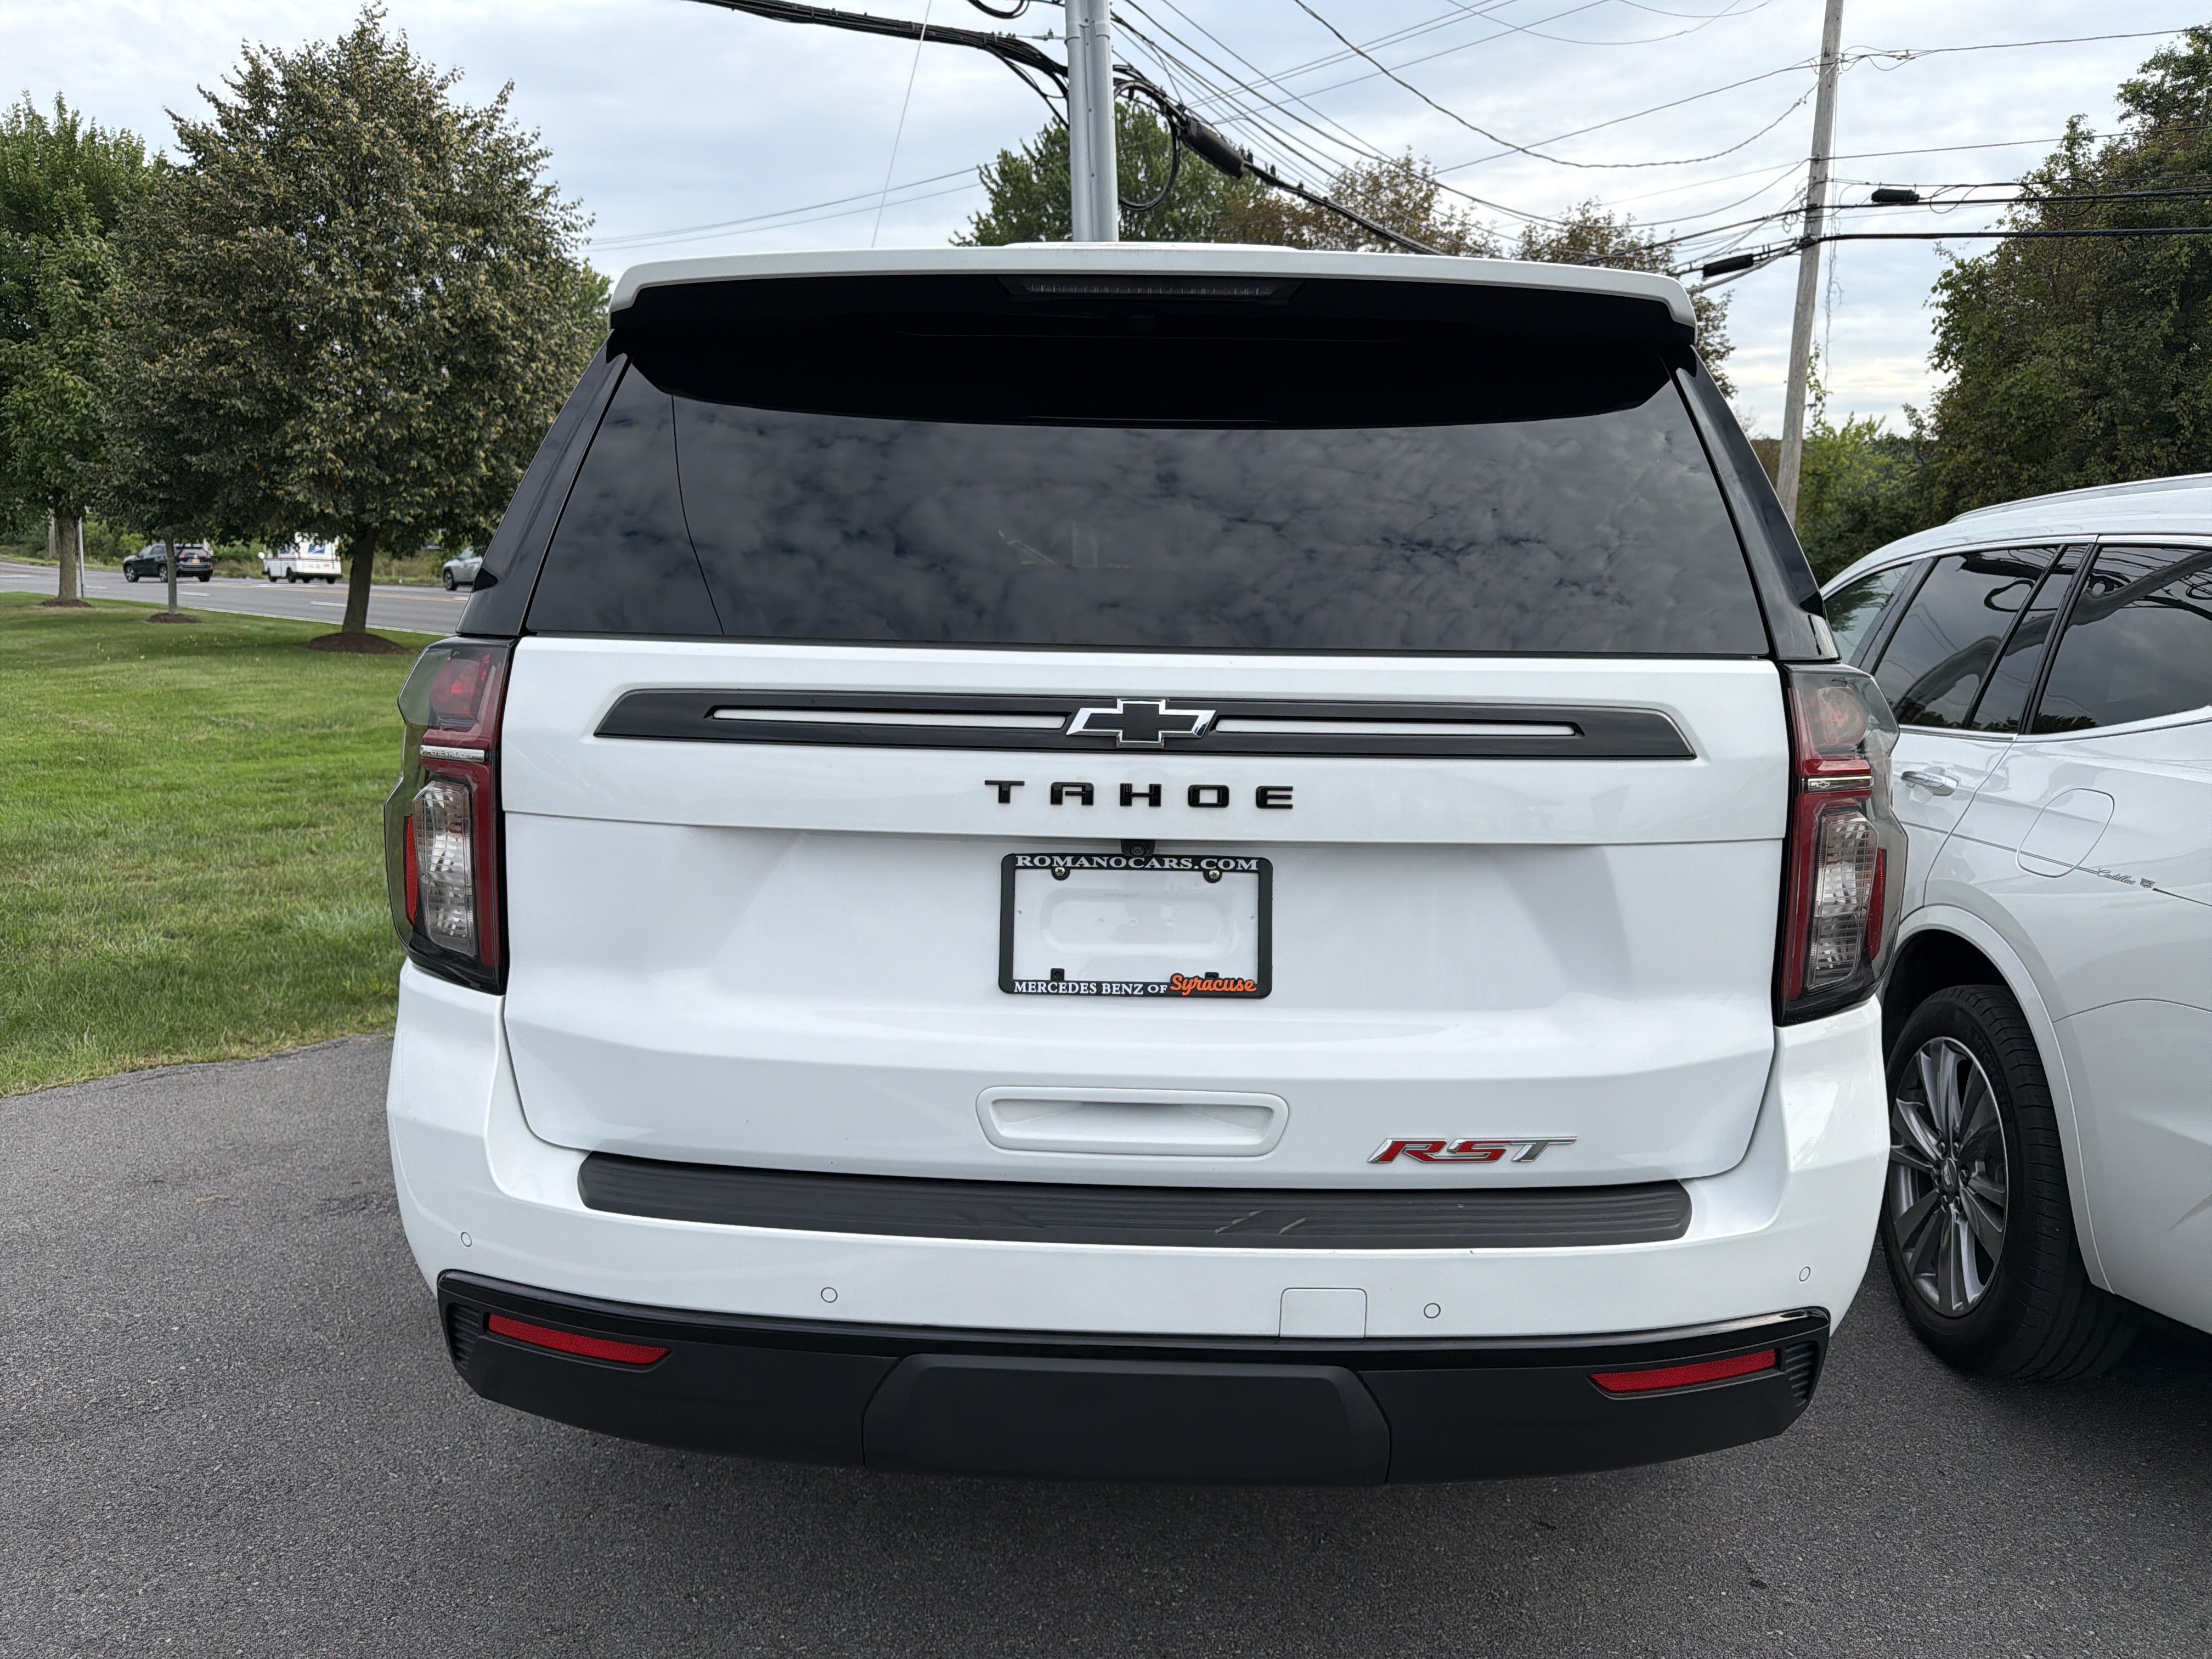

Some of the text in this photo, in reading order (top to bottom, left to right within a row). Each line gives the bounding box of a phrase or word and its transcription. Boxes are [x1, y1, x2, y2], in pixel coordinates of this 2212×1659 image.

[984, 780, 1294, 810] TAHOE
[1015, 855, 1259, 871] ROMANOCARS.COM
[2097, 867, 2136, 885] Cadillac
[1013, 974, 1257, 996] MERCEDES BENZ OF Syracuse
[1367, 1136, 1578, 1164] RST
